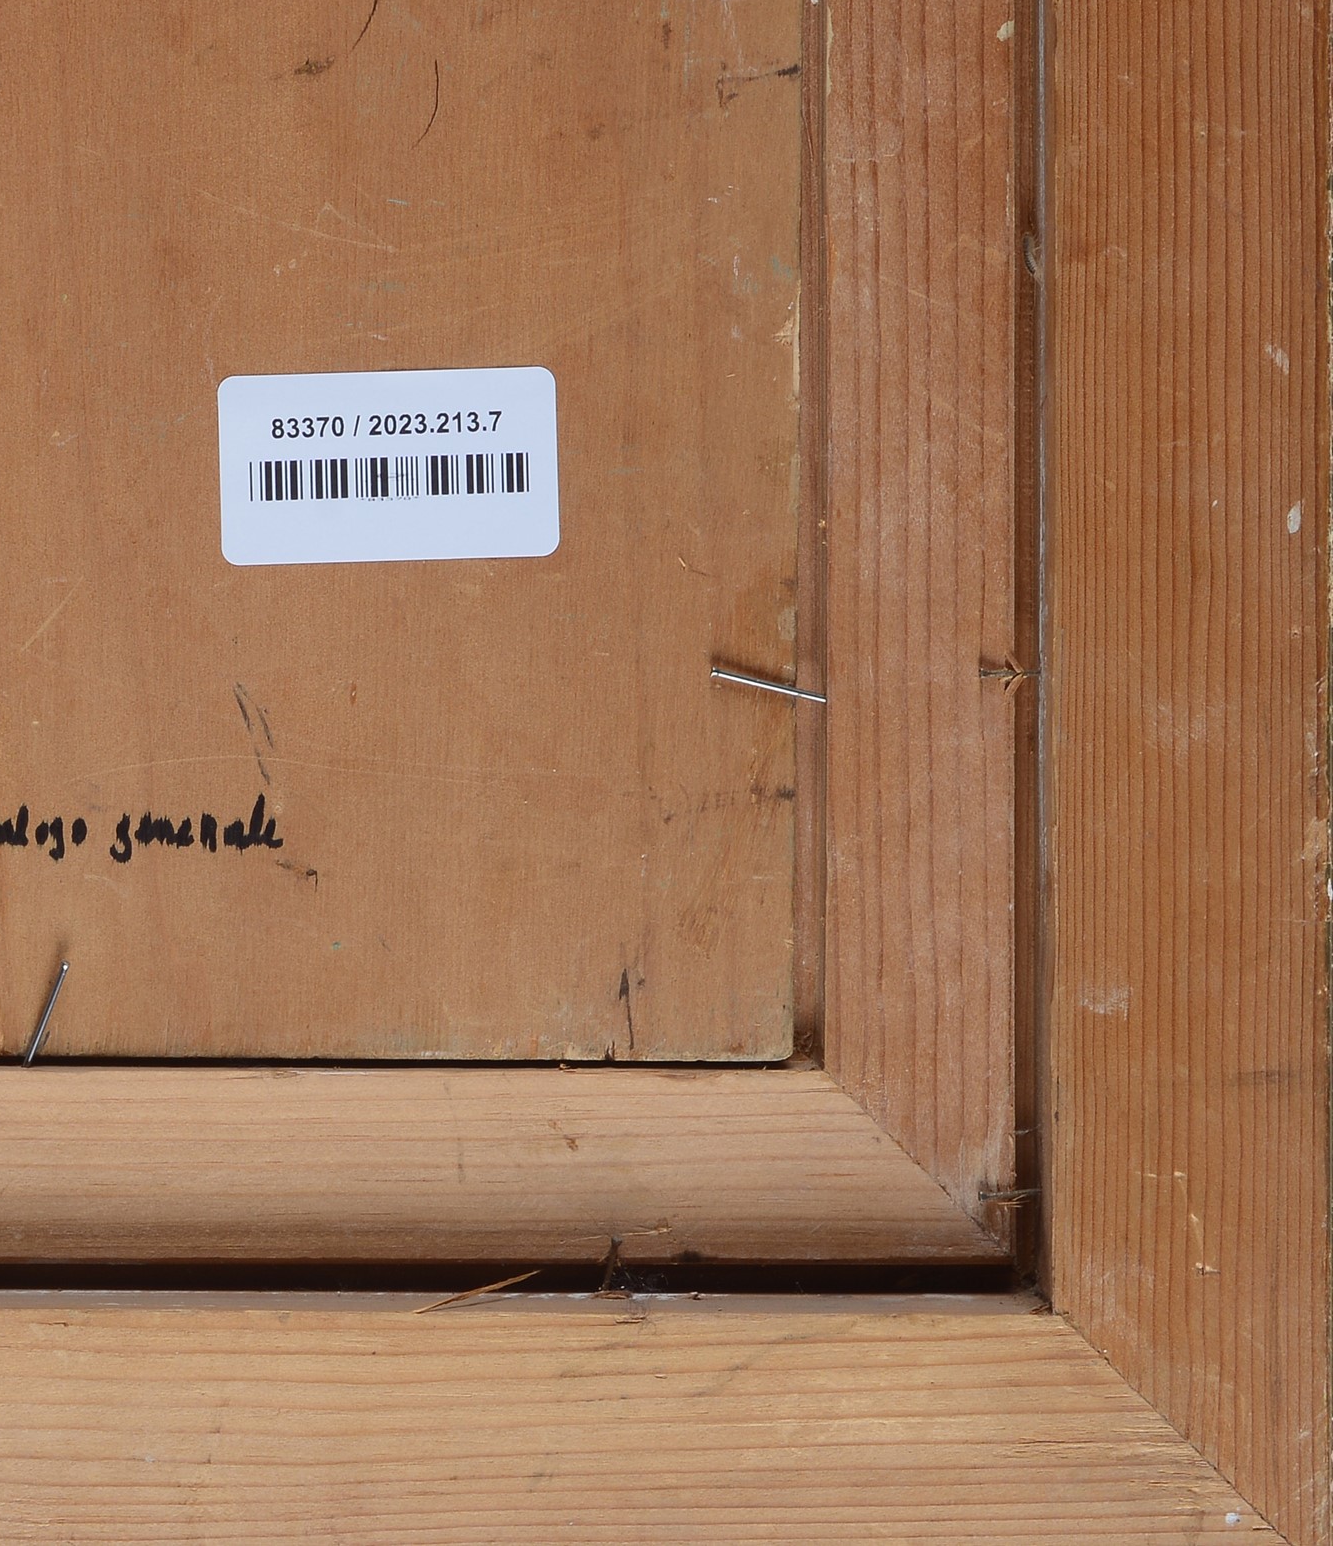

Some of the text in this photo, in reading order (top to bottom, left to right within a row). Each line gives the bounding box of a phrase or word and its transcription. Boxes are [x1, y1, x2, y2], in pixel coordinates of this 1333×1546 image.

[271, 410, 503, 439] 83370 / 2023.213.7
